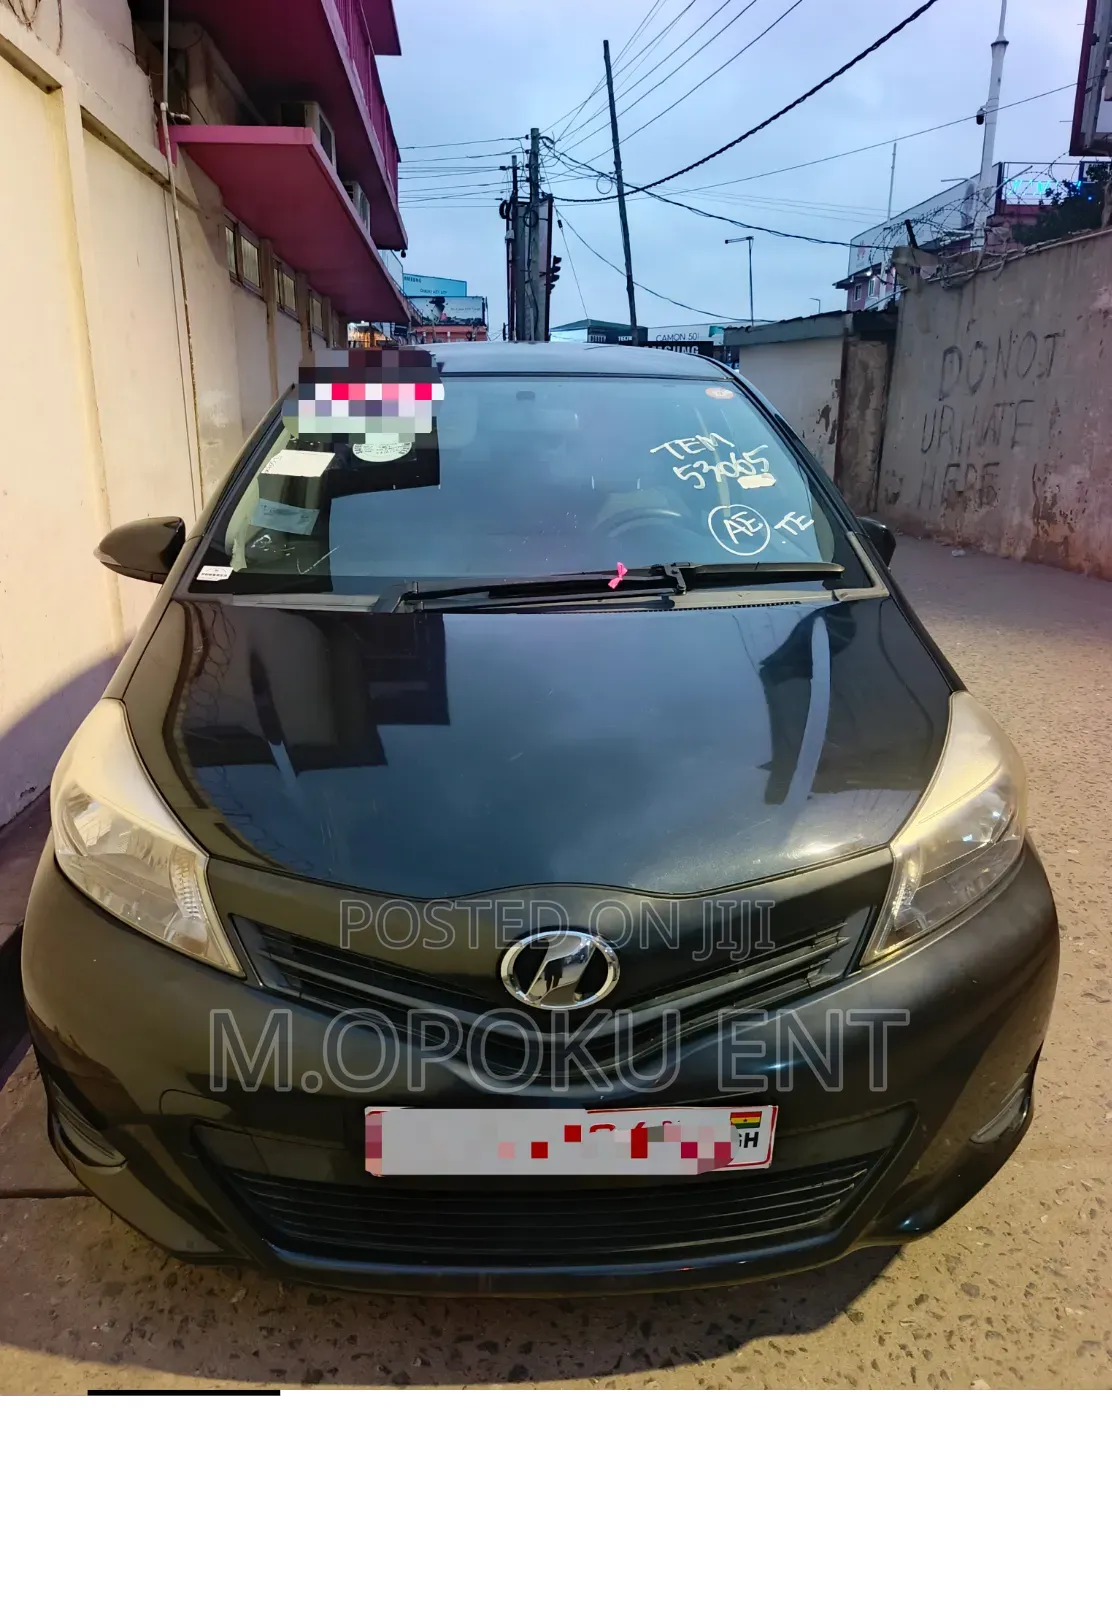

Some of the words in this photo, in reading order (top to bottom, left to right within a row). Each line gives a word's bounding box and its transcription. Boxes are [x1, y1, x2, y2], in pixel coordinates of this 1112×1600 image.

[655, 333, 686, 342] CAMON
[938, 341, 988, 401] DO
[992, 328, 1065, 389] NOT
[650, 433, 735, 459] TEM
